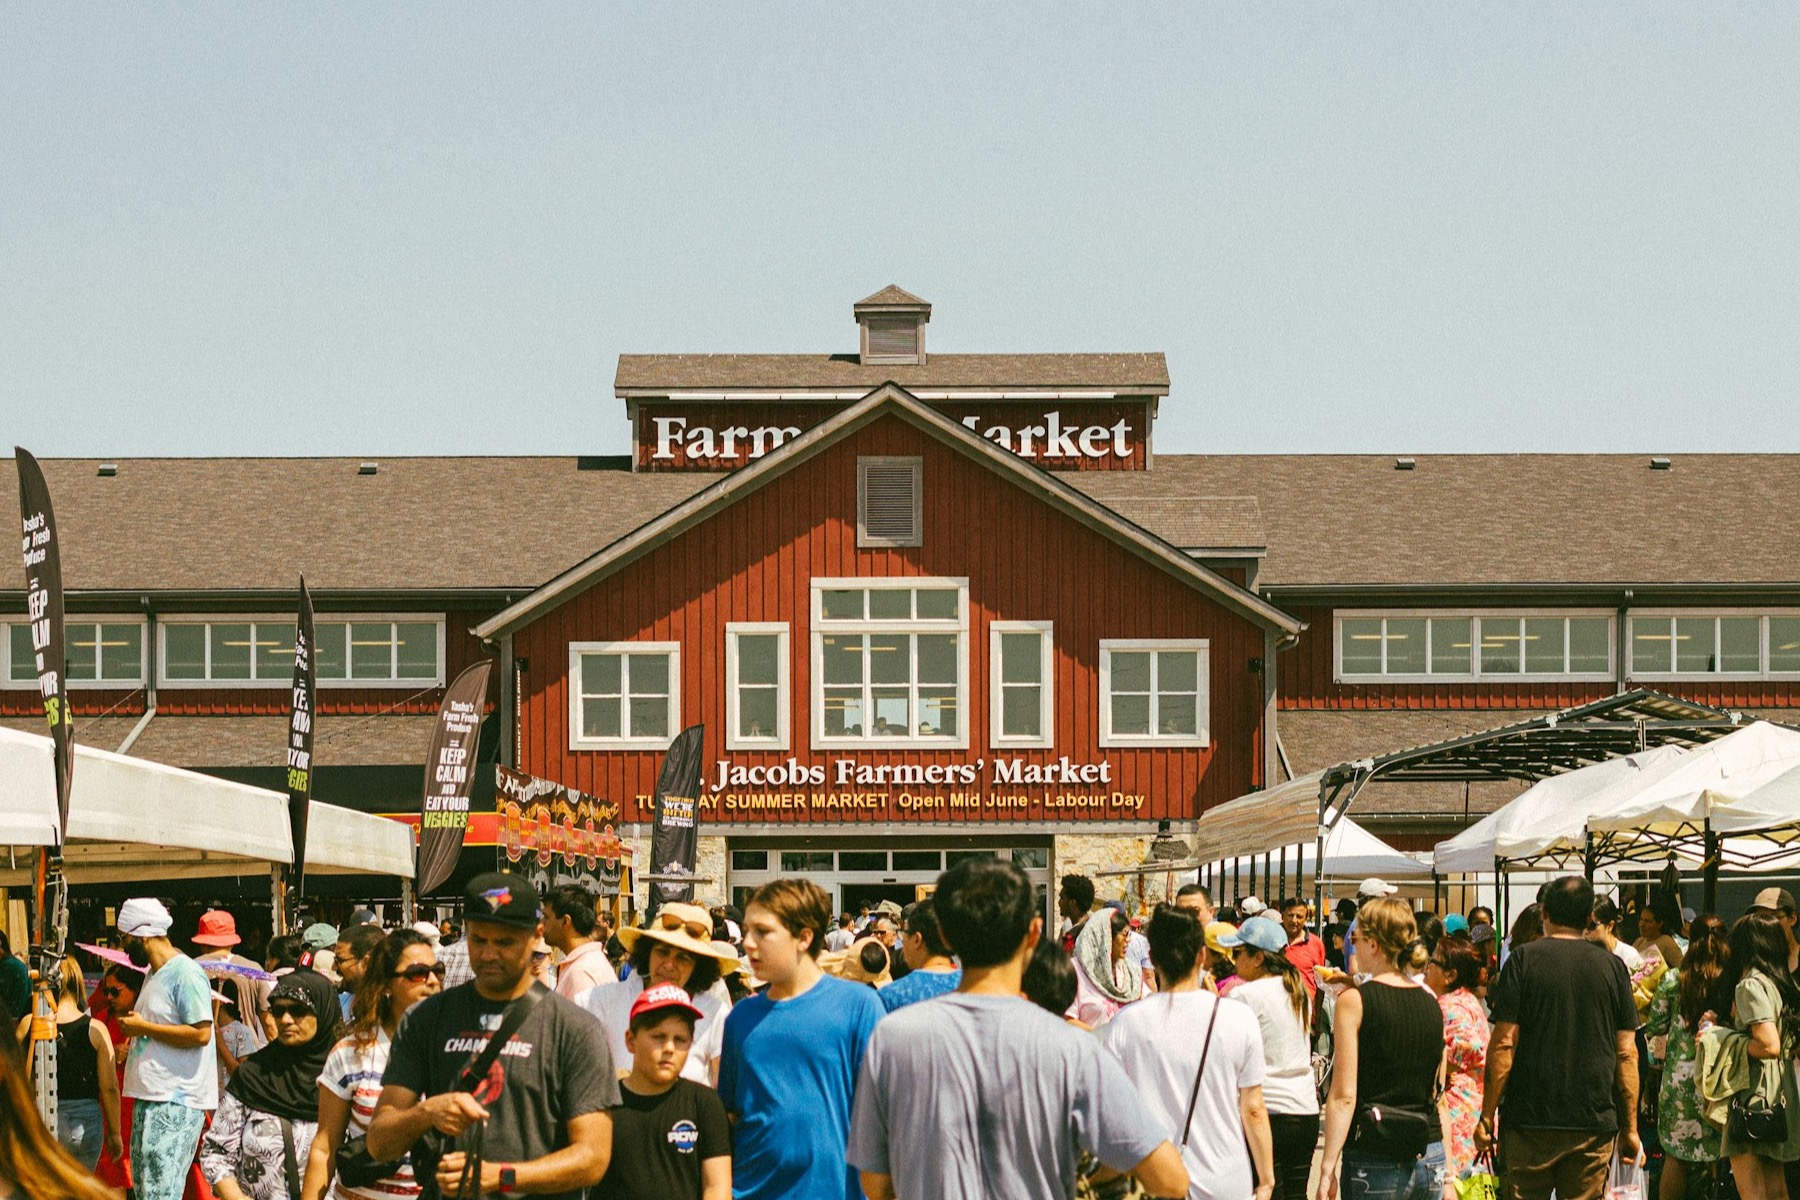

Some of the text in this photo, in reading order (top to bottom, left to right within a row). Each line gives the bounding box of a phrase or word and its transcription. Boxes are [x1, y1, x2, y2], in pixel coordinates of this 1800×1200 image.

[652, 411, 1133, 459] Farm arket
[451, 700, 475, 713] Tasha's
[442, 710, 460, 722] Farm
[436, 765, 467, 783] CALM
[711, 757, 825, 792] Jacobs
[993, 756, 1111, 784] Market
[442, 796, 469, 811] YOUR
[636, 794, 719, 809] TUAY
[726, 794, 806, 809] SUMMER
[812, 793, 888, 809] MARKET
[898, 793, 945, 811] Open
[950, 792, 980, 808] Mid
[986, 793, 1028, 808] June
[1045, 792, 1106, 808] Labour
[1112, 792, 1144, 810] Day
[664, 801, 694, 811] WE'RE
[662, 819, 693, 828] BREWING
[444, 1038, 532, 1057] CHAMONS
